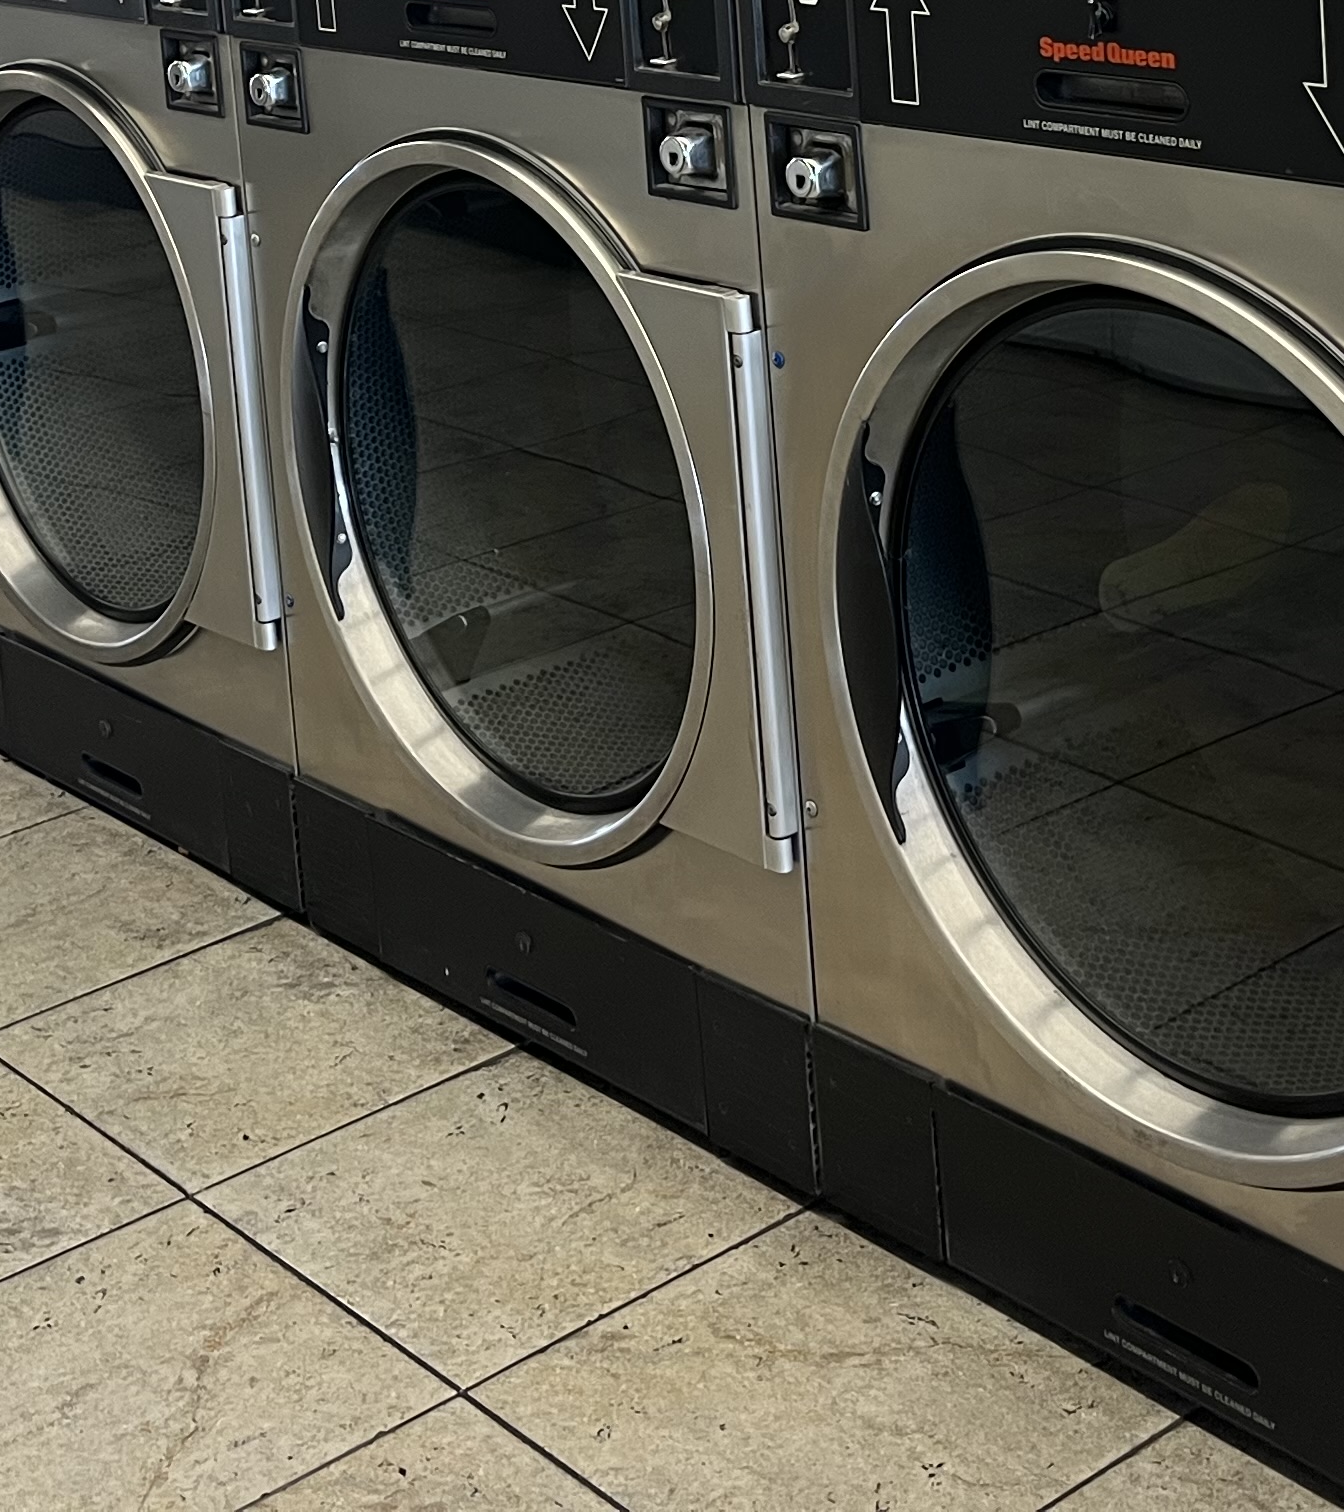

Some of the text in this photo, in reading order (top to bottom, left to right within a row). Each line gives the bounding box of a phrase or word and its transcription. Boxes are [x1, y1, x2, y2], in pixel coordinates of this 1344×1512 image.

[1039, 36, 1176, 69] Speed Queen
[1023, 118, 1203, 150] LINT COMPARTMENT MUST BE CLEANED DAILY
